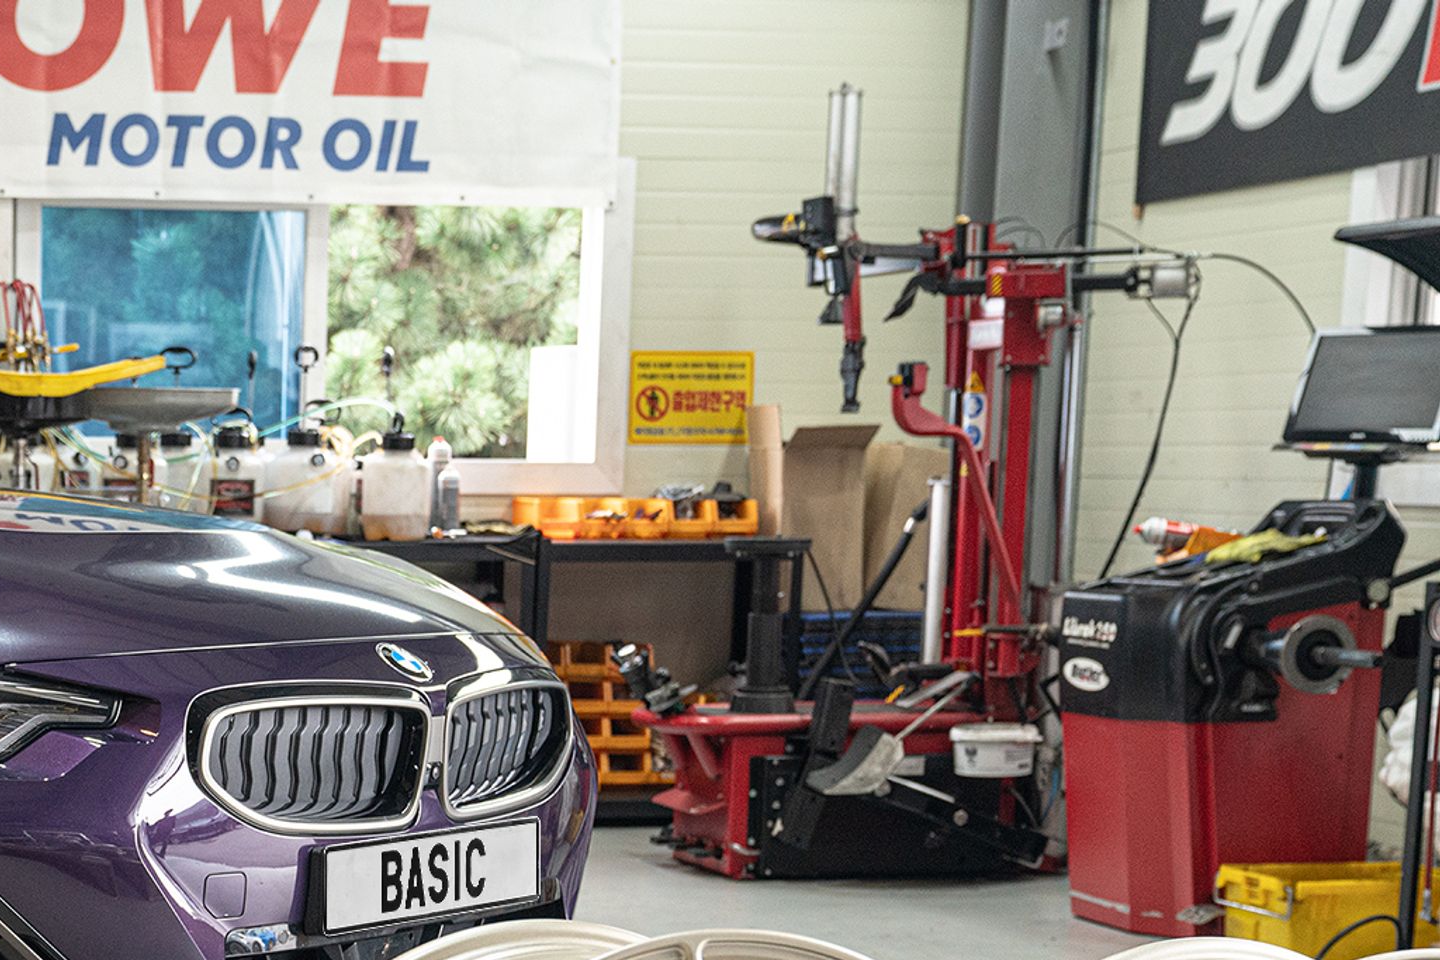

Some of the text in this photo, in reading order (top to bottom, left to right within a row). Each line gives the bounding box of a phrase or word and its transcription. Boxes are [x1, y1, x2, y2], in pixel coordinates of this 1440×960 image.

[1159, 0, 1440, 147] 300
[46, 112, 431, 173] MOTOR OIL
[380, 837, 487, 914] BASIC
